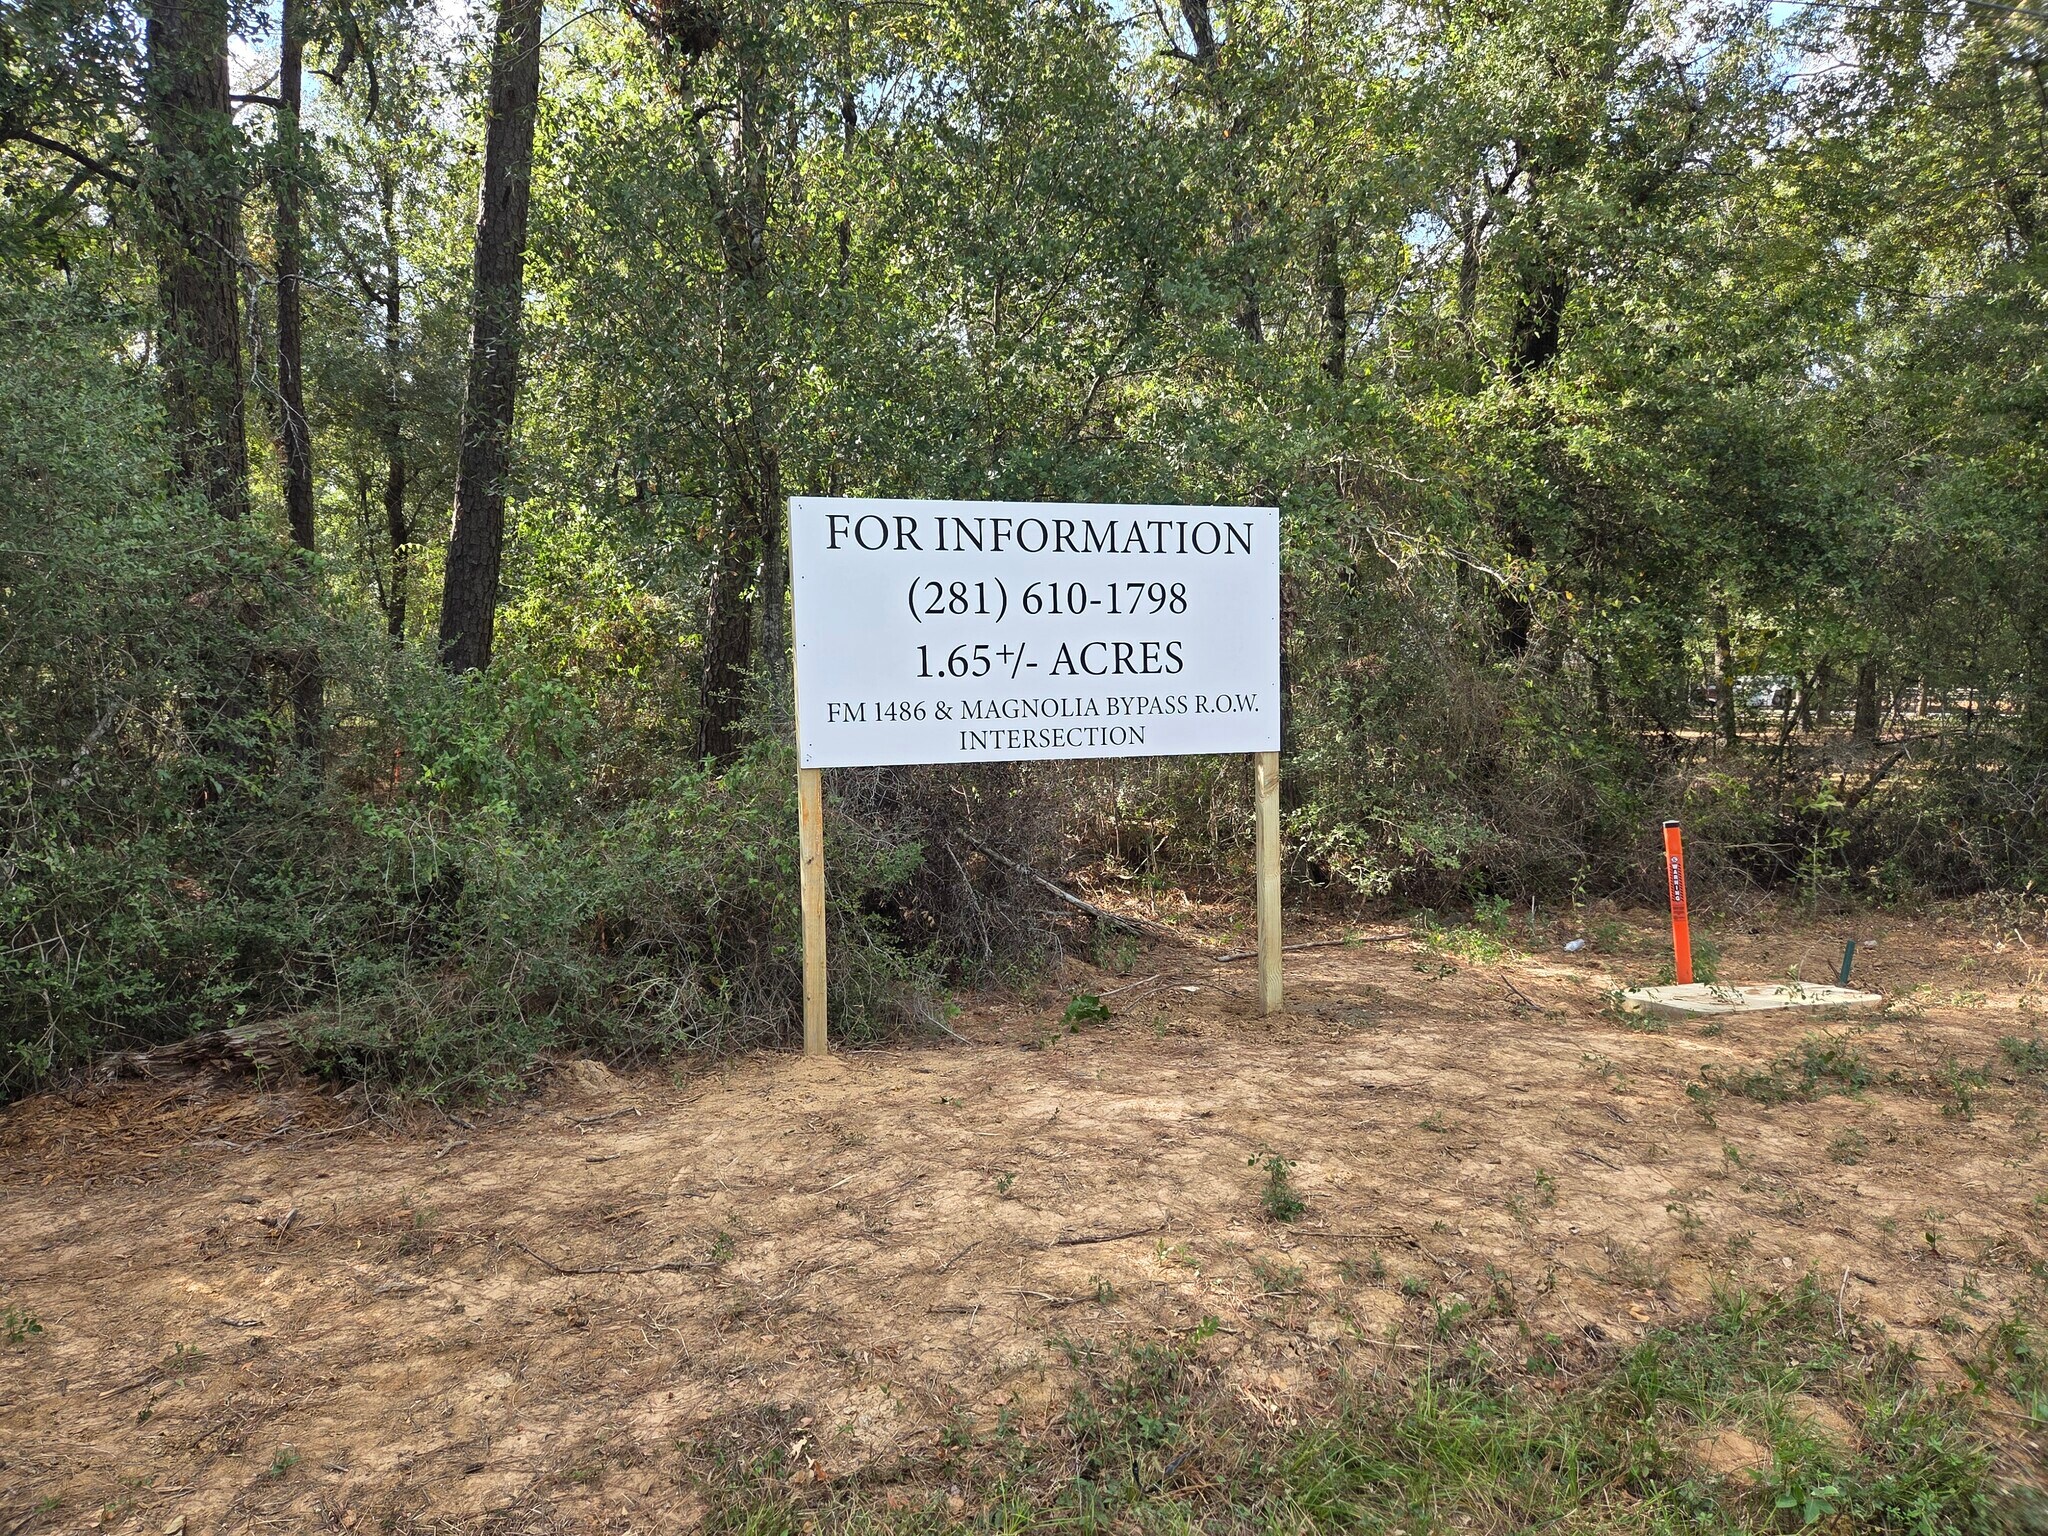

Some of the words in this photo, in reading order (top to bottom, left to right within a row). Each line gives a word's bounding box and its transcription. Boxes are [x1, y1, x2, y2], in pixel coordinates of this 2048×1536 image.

[824, 514, 924, 551] FOR
[934, 516, 1254, 555] INFORMATION
[908, 576, 1008, 624] (281)
[1022, 581, 1188, 615] 610-1798
[1048, 640, 1184, 676] ACRES
[826, 702, 867, 723] FM
[875, 700, 927, 722] 1486
[934, 700, 953, 721] &
[960, 697, 1100, 720] MAGNOLIA
[1106, 695, 1188, 716] BYPASS
[1195, 693, 1259, 714] R.O.W.
[959, 725, 1146, 751] INTERSECTION
[1671, 863, 1681, 902] WARNING
